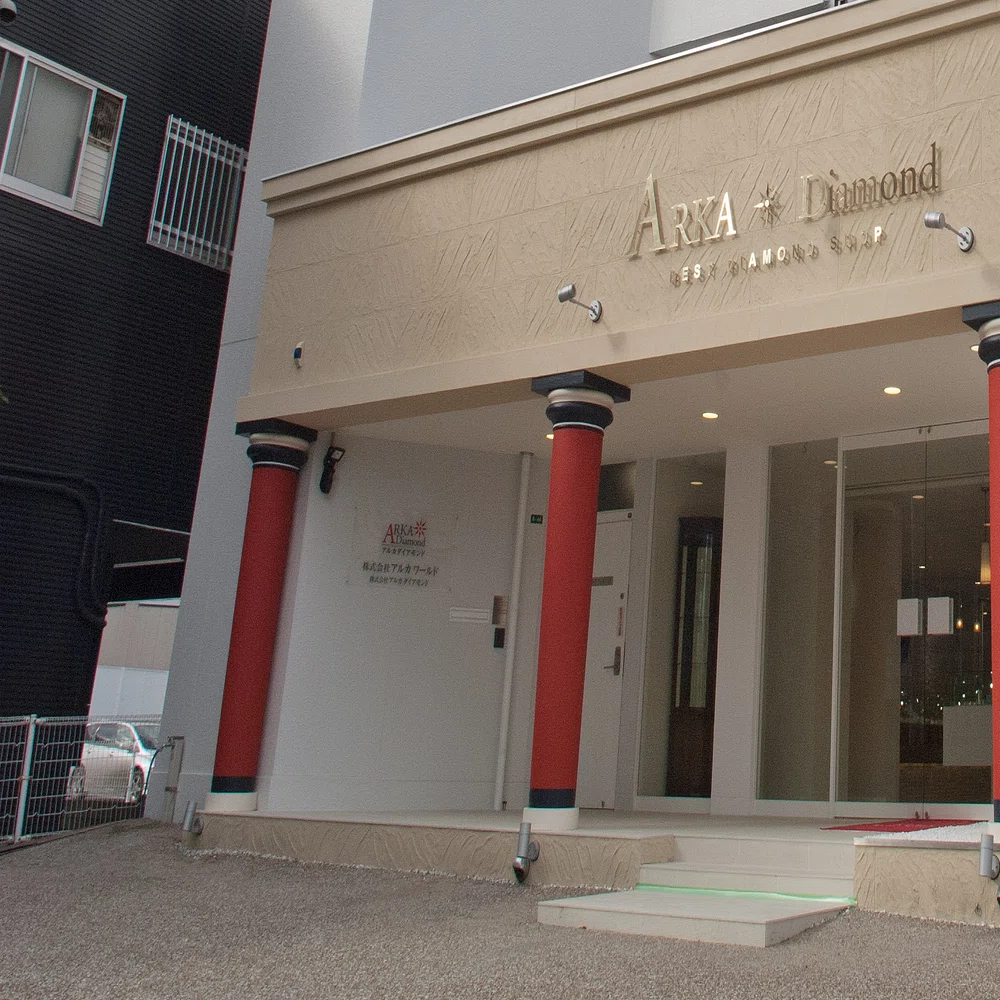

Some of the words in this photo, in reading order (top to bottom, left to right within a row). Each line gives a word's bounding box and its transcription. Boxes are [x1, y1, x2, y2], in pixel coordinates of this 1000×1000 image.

[628, 173, 737, 259] ARKA
[798, 142, 940, 221] Diamond
[382, 523, 414, 544] ARKA
[395, 535, 426, 547] Diamond
